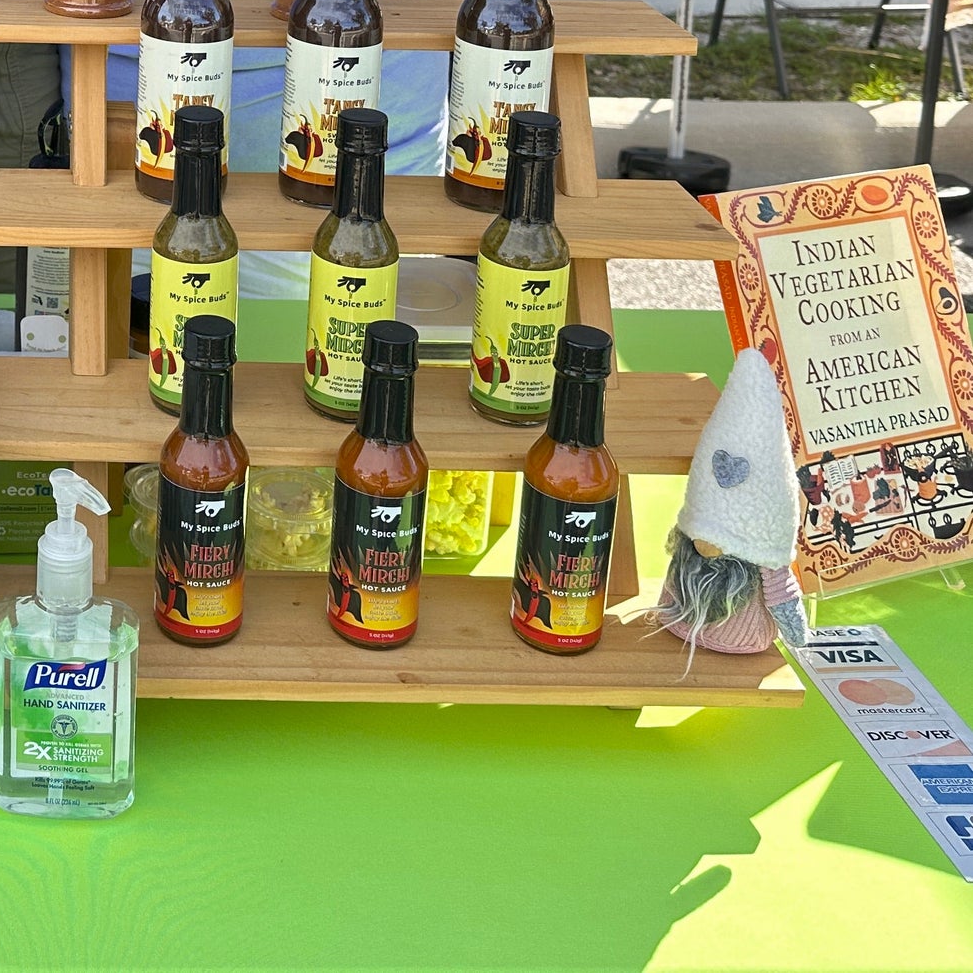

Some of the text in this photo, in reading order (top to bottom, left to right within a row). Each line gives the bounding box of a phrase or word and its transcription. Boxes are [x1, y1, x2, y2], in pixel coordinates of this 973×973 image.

[167, 73, 179, 81] My
[181, 74, 202, 83] Spice
[318, 78, 331, 87] My
[333, 79, 355, 87] Spice
[488, 80, 501, 90] My
[503, 82, 526, 91] Spice
[791, 234, 876, 267] INDIAN
[770, 259, 916, 300] VEGETARIAN
[169, 292, 181, 303] My
[183, 295, 207, 304] Spice
[324, 294, 336, 305] My
[337, 298, 361, 308] Spice
[505, 300, 519, 310] My
[521, 302, 545, 312] Spice
[798, 291, 901, 326] COOKING
[328, 317, 369, 337] SUPE
[510, 322, 556, 341] SUPER
[829, 327, 881, 348] FROM AN
[328, 352, 343, 361] HOT
[529, 358, 552, 366] SAUCE
[806, 345, 923, 385] AMERICAN
[816, 376, 923, 414] KITCHEN
[808, 405, 950, 446] VASANTHA PRASAD
[7, 485, 54, 497] ecoTa
[180, 520, 194, 532] My
[196, 524, 221, 534] Spice
[356, 524, 370, 536] My
[371, 529, 397, 539] Spice
[548, 530, 563, 542] My
[565, 534, 590, 544] Spice
[190, 544, 231, 562] FIERY
[365, 548, 407, 568] FIERY
[184, 560, 234, 580] MIRCHI
[556, 554, 599, 573] FIERY
[358, 564, 411, 584] MIRCHI
[549, 571, 601, 590] MIRCHI
[186, 579, 232, 588] HOT SAUCE
[361, 584, 407, 593] HOT SAUCE
[551, 589, 596, 598] HOT SAUCE
[813, 650, 884, 664] VISA
[34, 664, 100, 688] Purell
[23, 699, 107, 711] HAND SANITIZER
[857, 706, 926, 715] mastercard
[867, 729, 954, 742] DISCOVER
[23, 741, 53, 761] 2X
[53, 747, 104, 757] SANITIZING
[53, 754, 99, 763] STRENGTH
[38, 764, 89, 774] SOOTHING GEL
